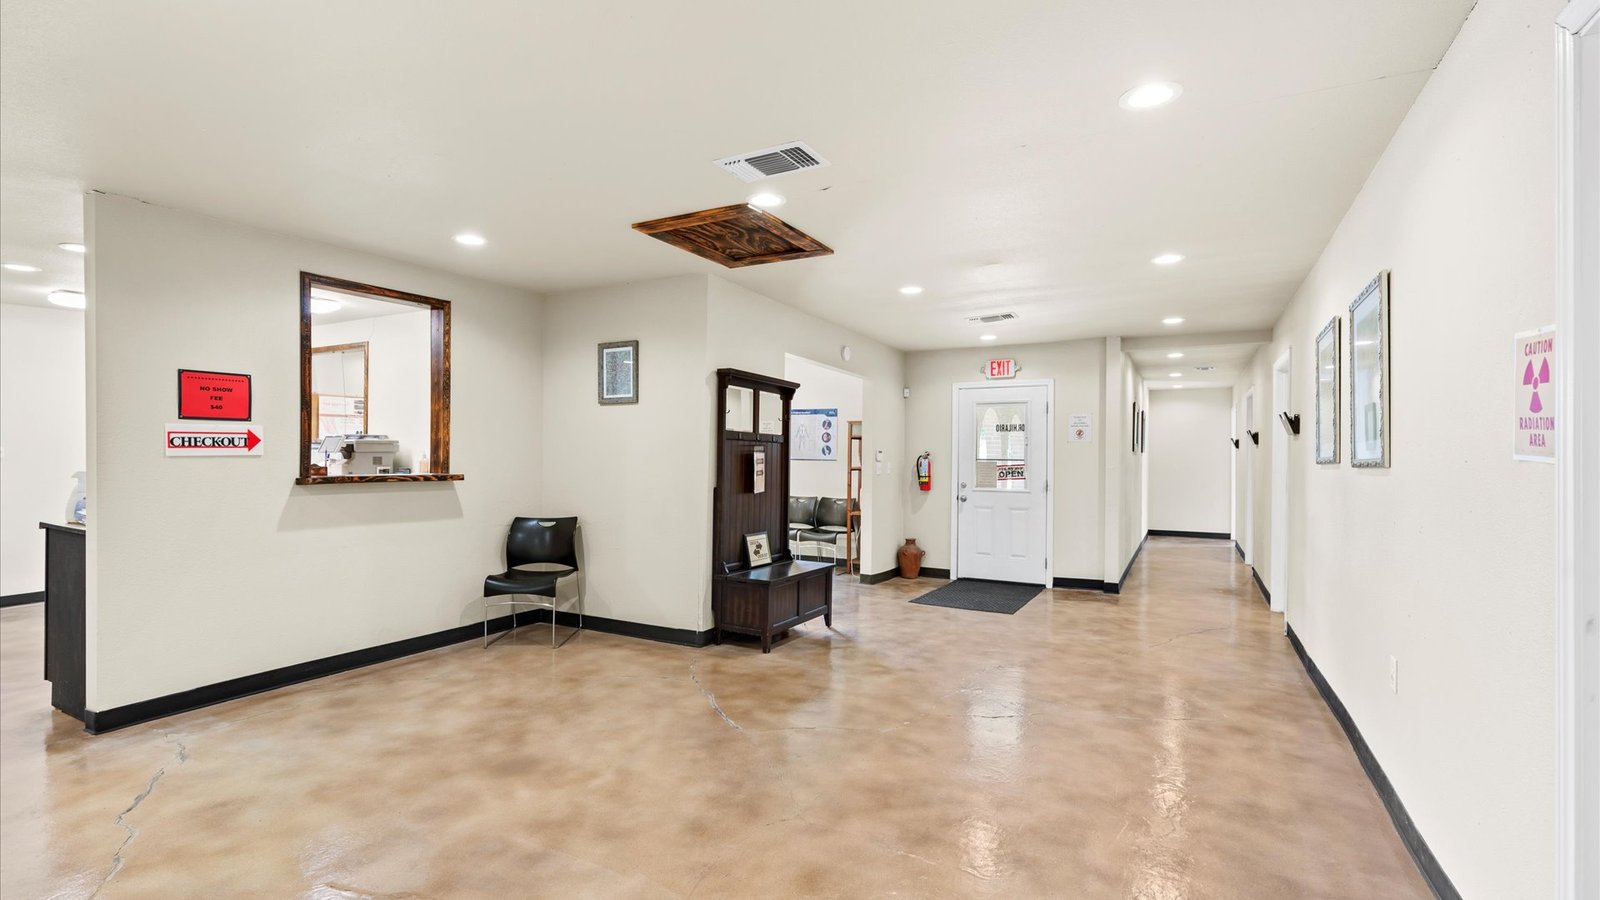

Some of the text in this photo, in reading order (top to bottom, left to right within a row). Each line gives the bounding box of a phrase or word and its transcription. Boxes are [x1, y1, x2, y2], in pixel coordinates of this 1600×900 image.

[1524, 338, 1553, 356] CAUTION
[990, 360, 1011, 376] EXIT
[1519, 416, 1555, 431] RADIATION
[1529, 433, 1546, 447] AREA
[998, 470, 1024, 478] OPEN
